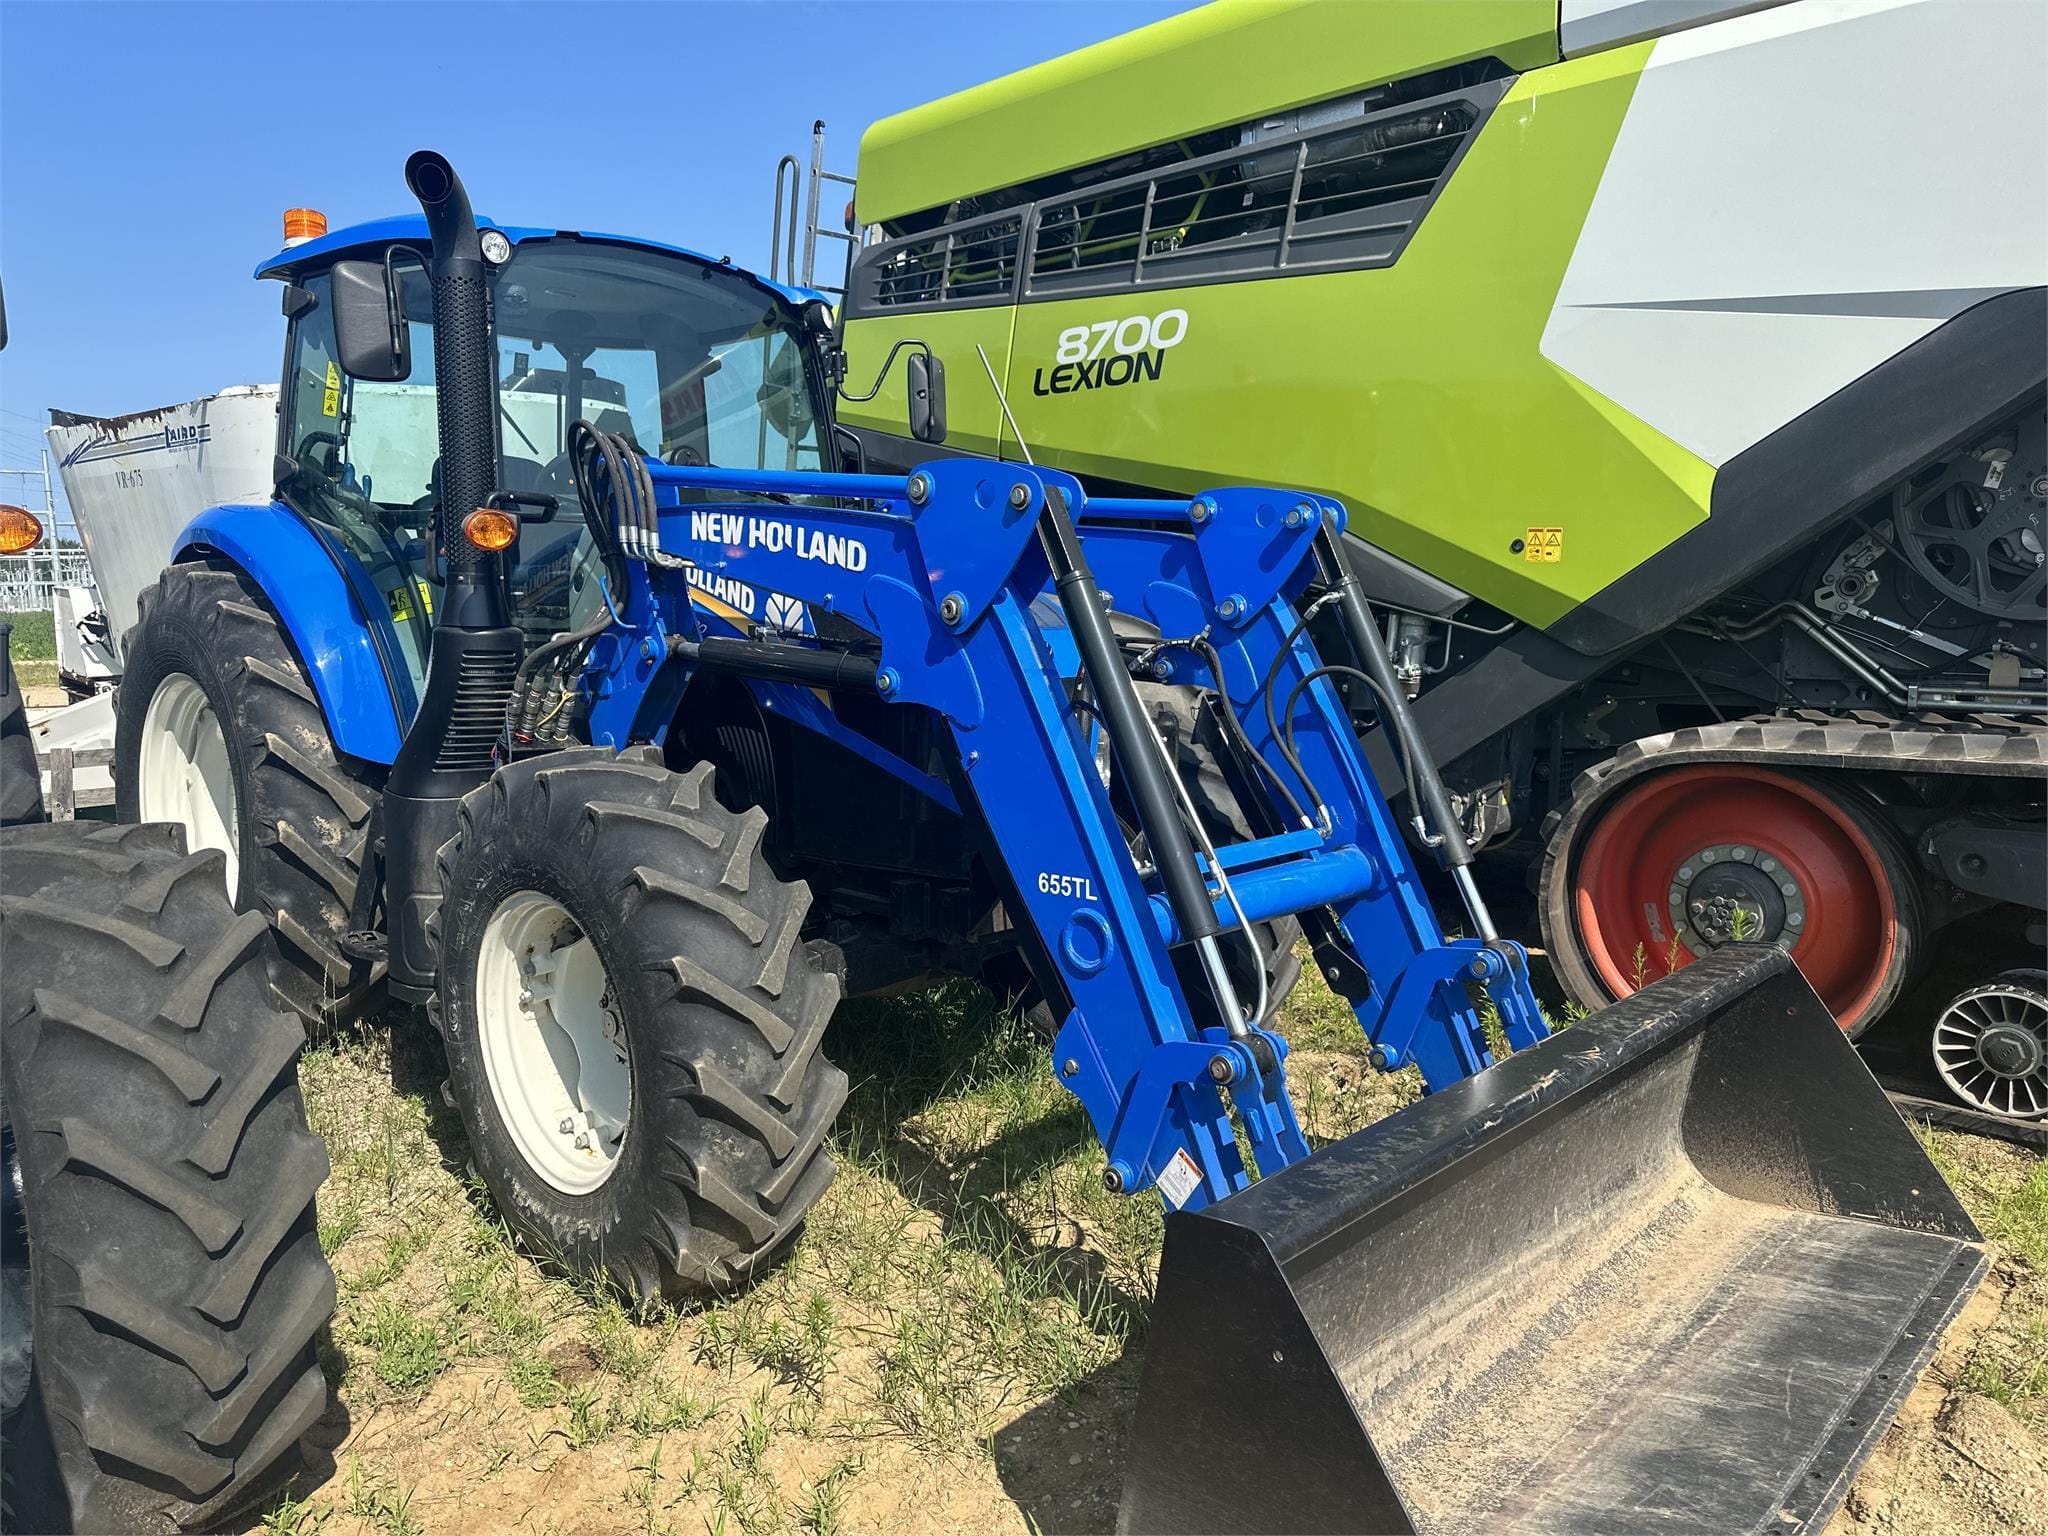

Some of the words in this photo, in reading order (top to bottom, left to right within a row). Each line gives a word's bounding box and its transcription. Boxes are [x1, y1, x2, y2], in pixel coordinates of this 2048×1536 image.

[1056, 308, 1189, 365] 8700
[1033, 348, 1166, 397] LEXION
[115, 469, 144, 489] VR-675
[691, 511, 744, 546] NEW
[748, 517, 867, 572] HOLLAND
[685, 567, 755, 615] OLLAND
[1038, 871, 1098, 901] 655TL
